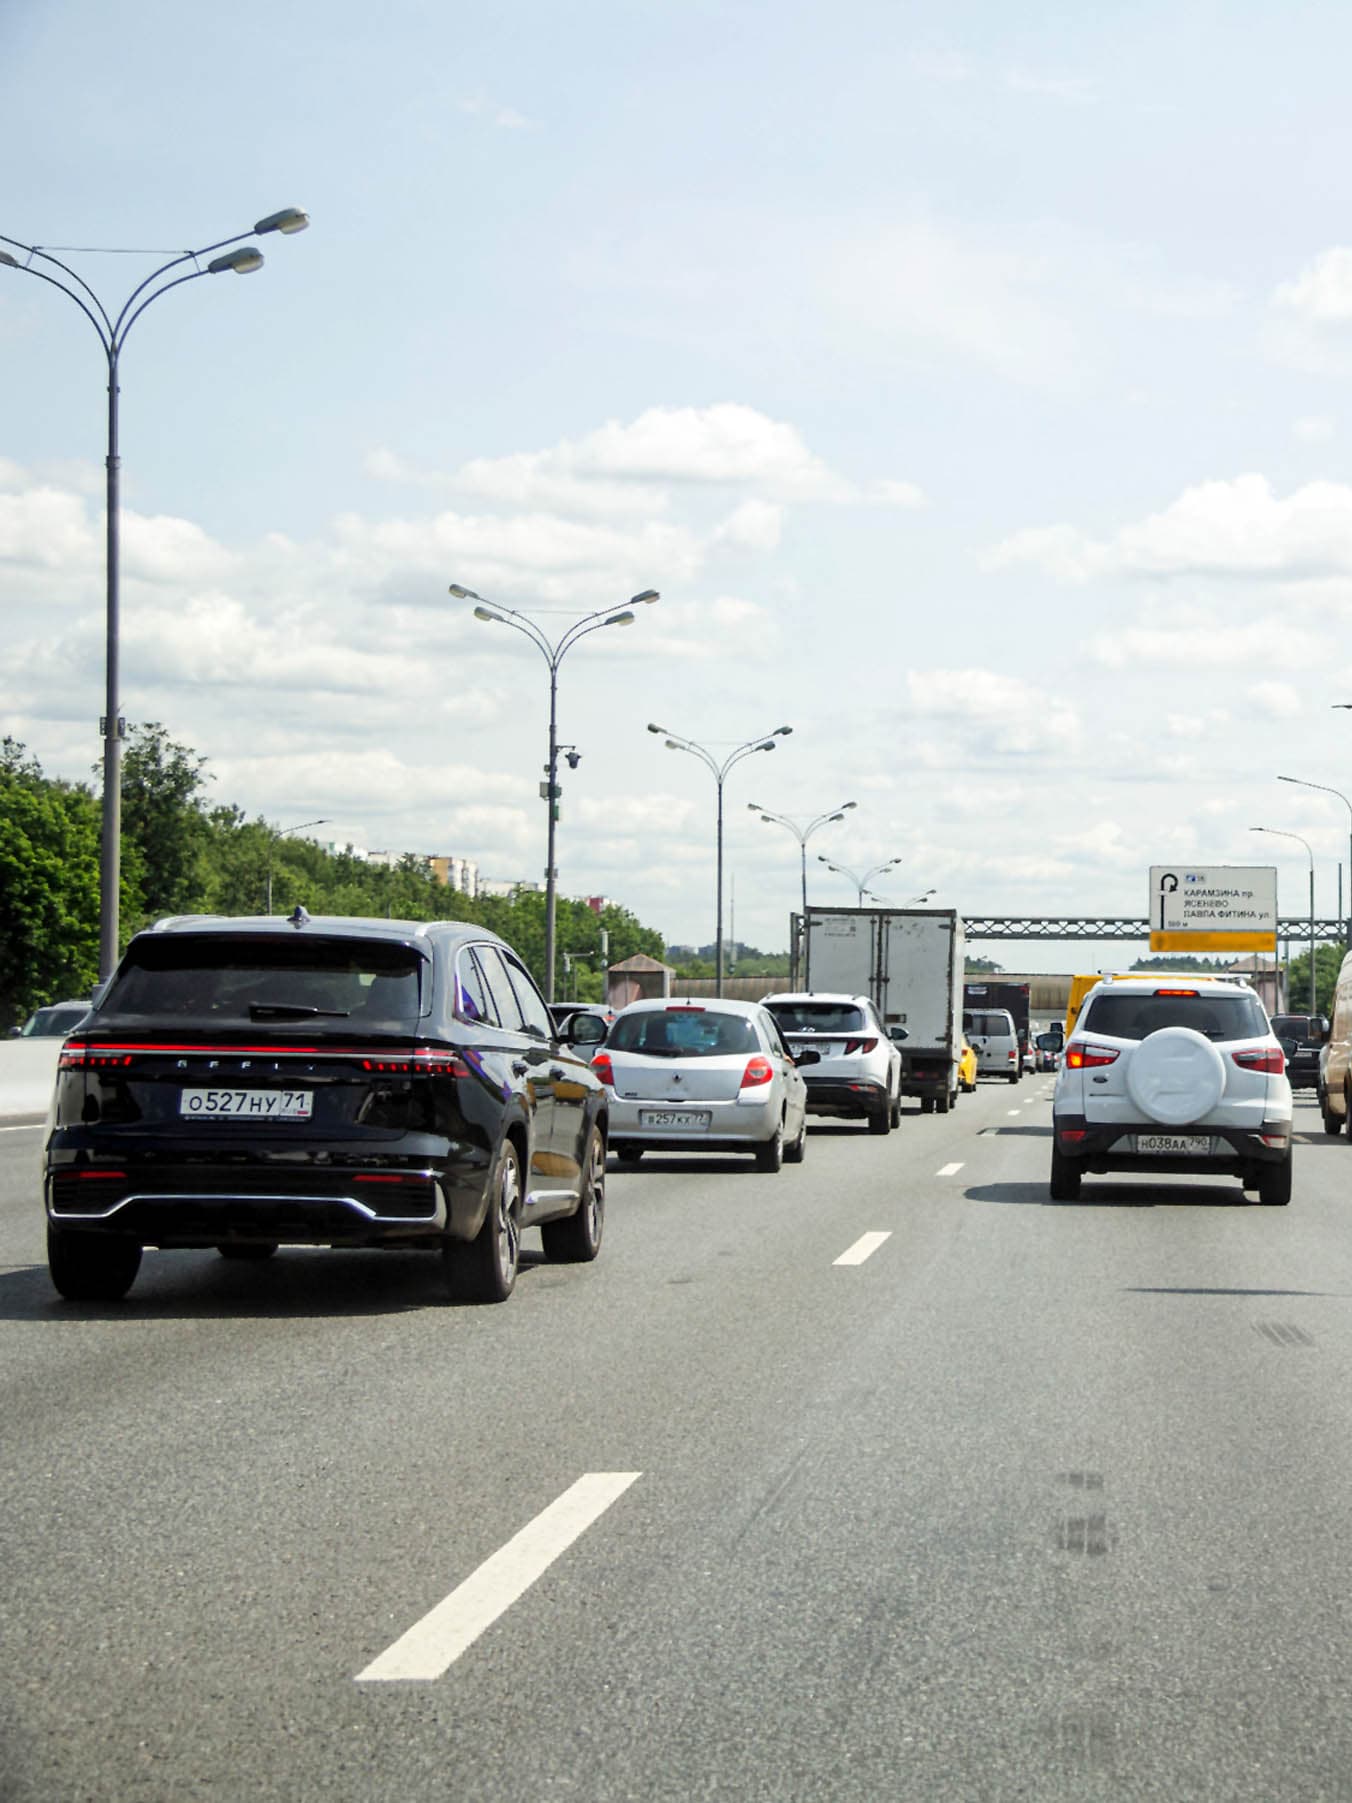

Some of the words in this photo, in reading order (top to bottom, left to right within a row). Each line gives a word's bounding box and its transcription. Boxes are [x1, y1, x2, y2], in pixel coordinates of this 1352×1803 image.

[1183, 889, 1240, 898] КАРАМЗИНА
[1183, 899, 1229, 908] ЯСЕНЕВО
[1183, 910, 1216, 919] ПАВЛА
[1217, 910, 1256, 919] ФИТИНА
